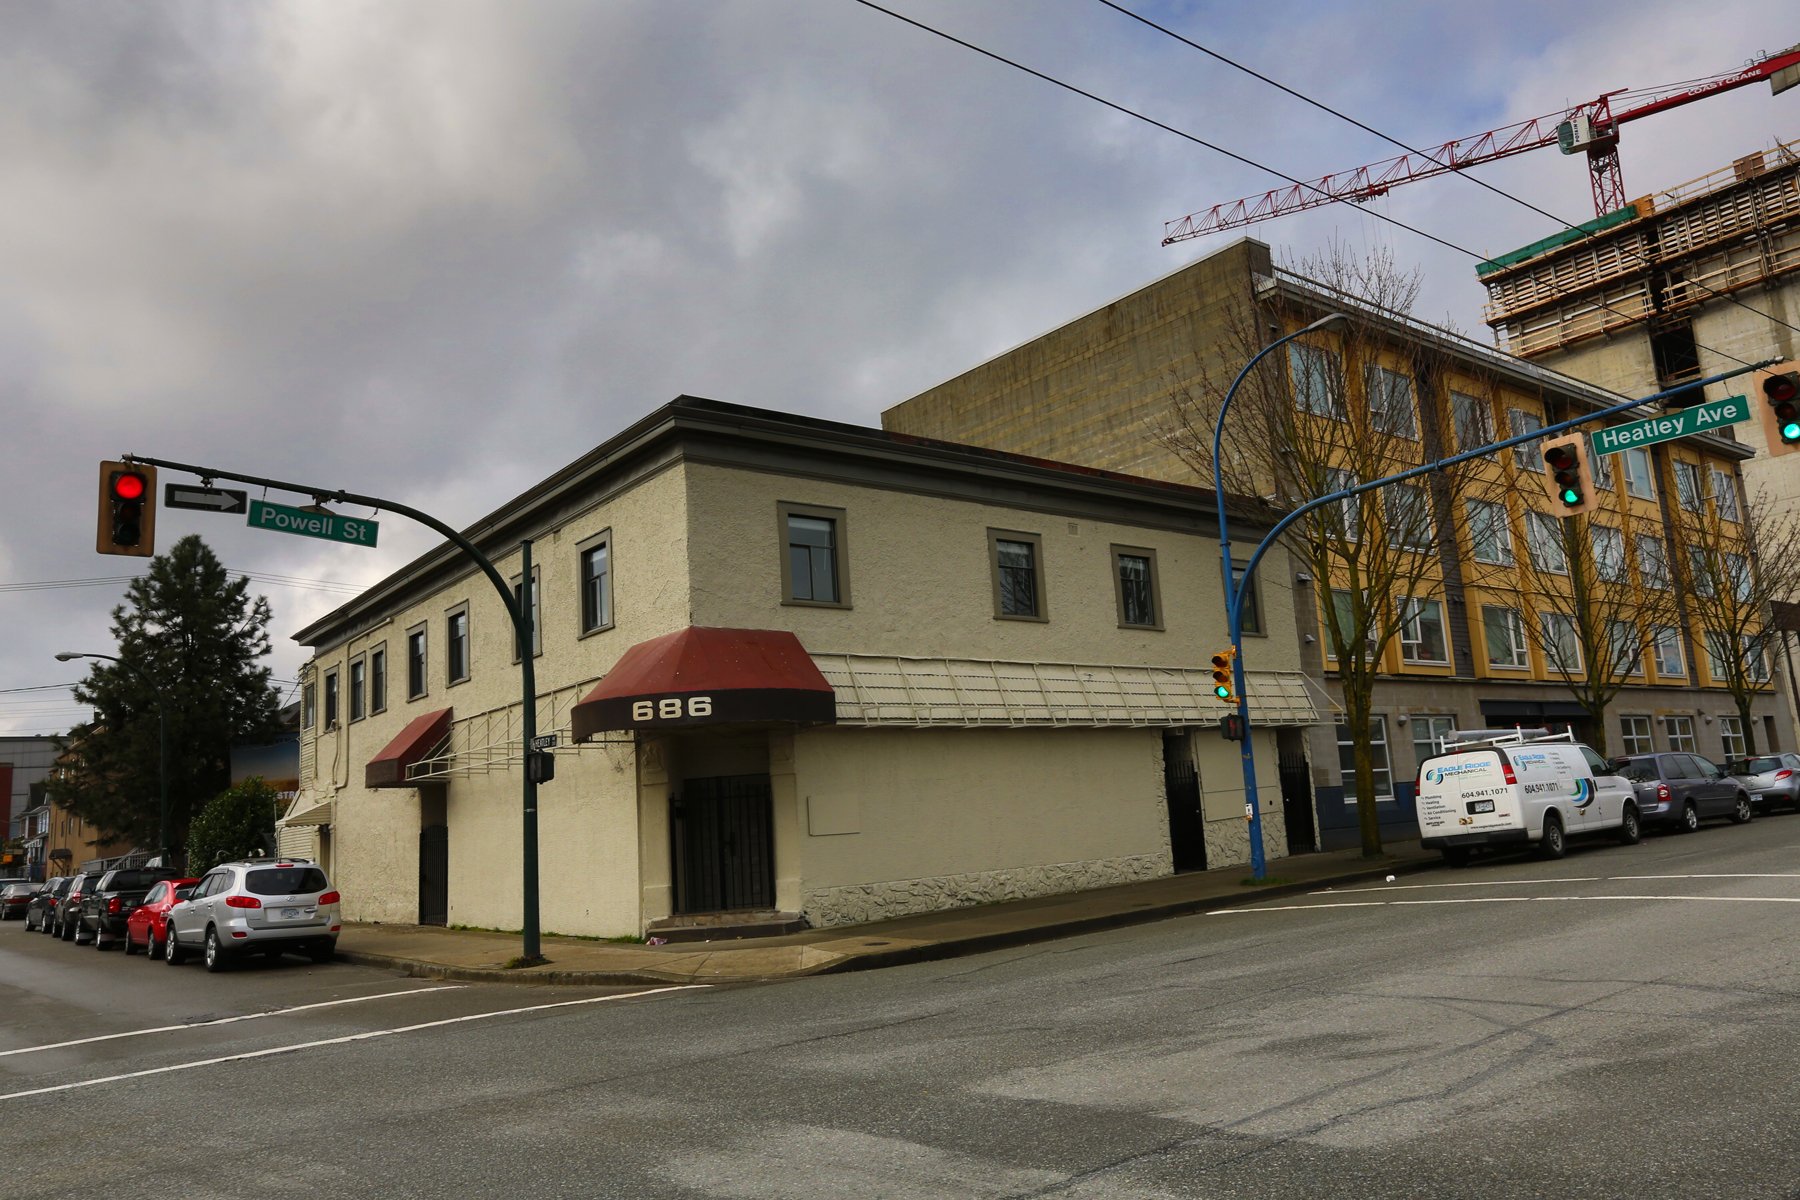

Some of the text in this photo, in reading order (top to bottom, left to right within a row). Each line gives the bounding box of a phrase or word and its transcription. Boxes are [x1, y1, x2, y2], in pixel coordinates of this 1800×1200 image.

[1688, 68, 1762, 96] COAST CRANE
[1572, 119, 1580, 143] POTAIN
[1602, 404, 1738, 448] Heatley Ave
[260, 506, 367, 541] Powell St
[632, 696, 713, 722] 686
[1445, 768, 1487, 777] MECHANICAL
[276, 790, 296, 800] STR
[1461, 788, 1508, 799] 604.941.1071
[1524, 782, 1559, 794] 604.941.1071
